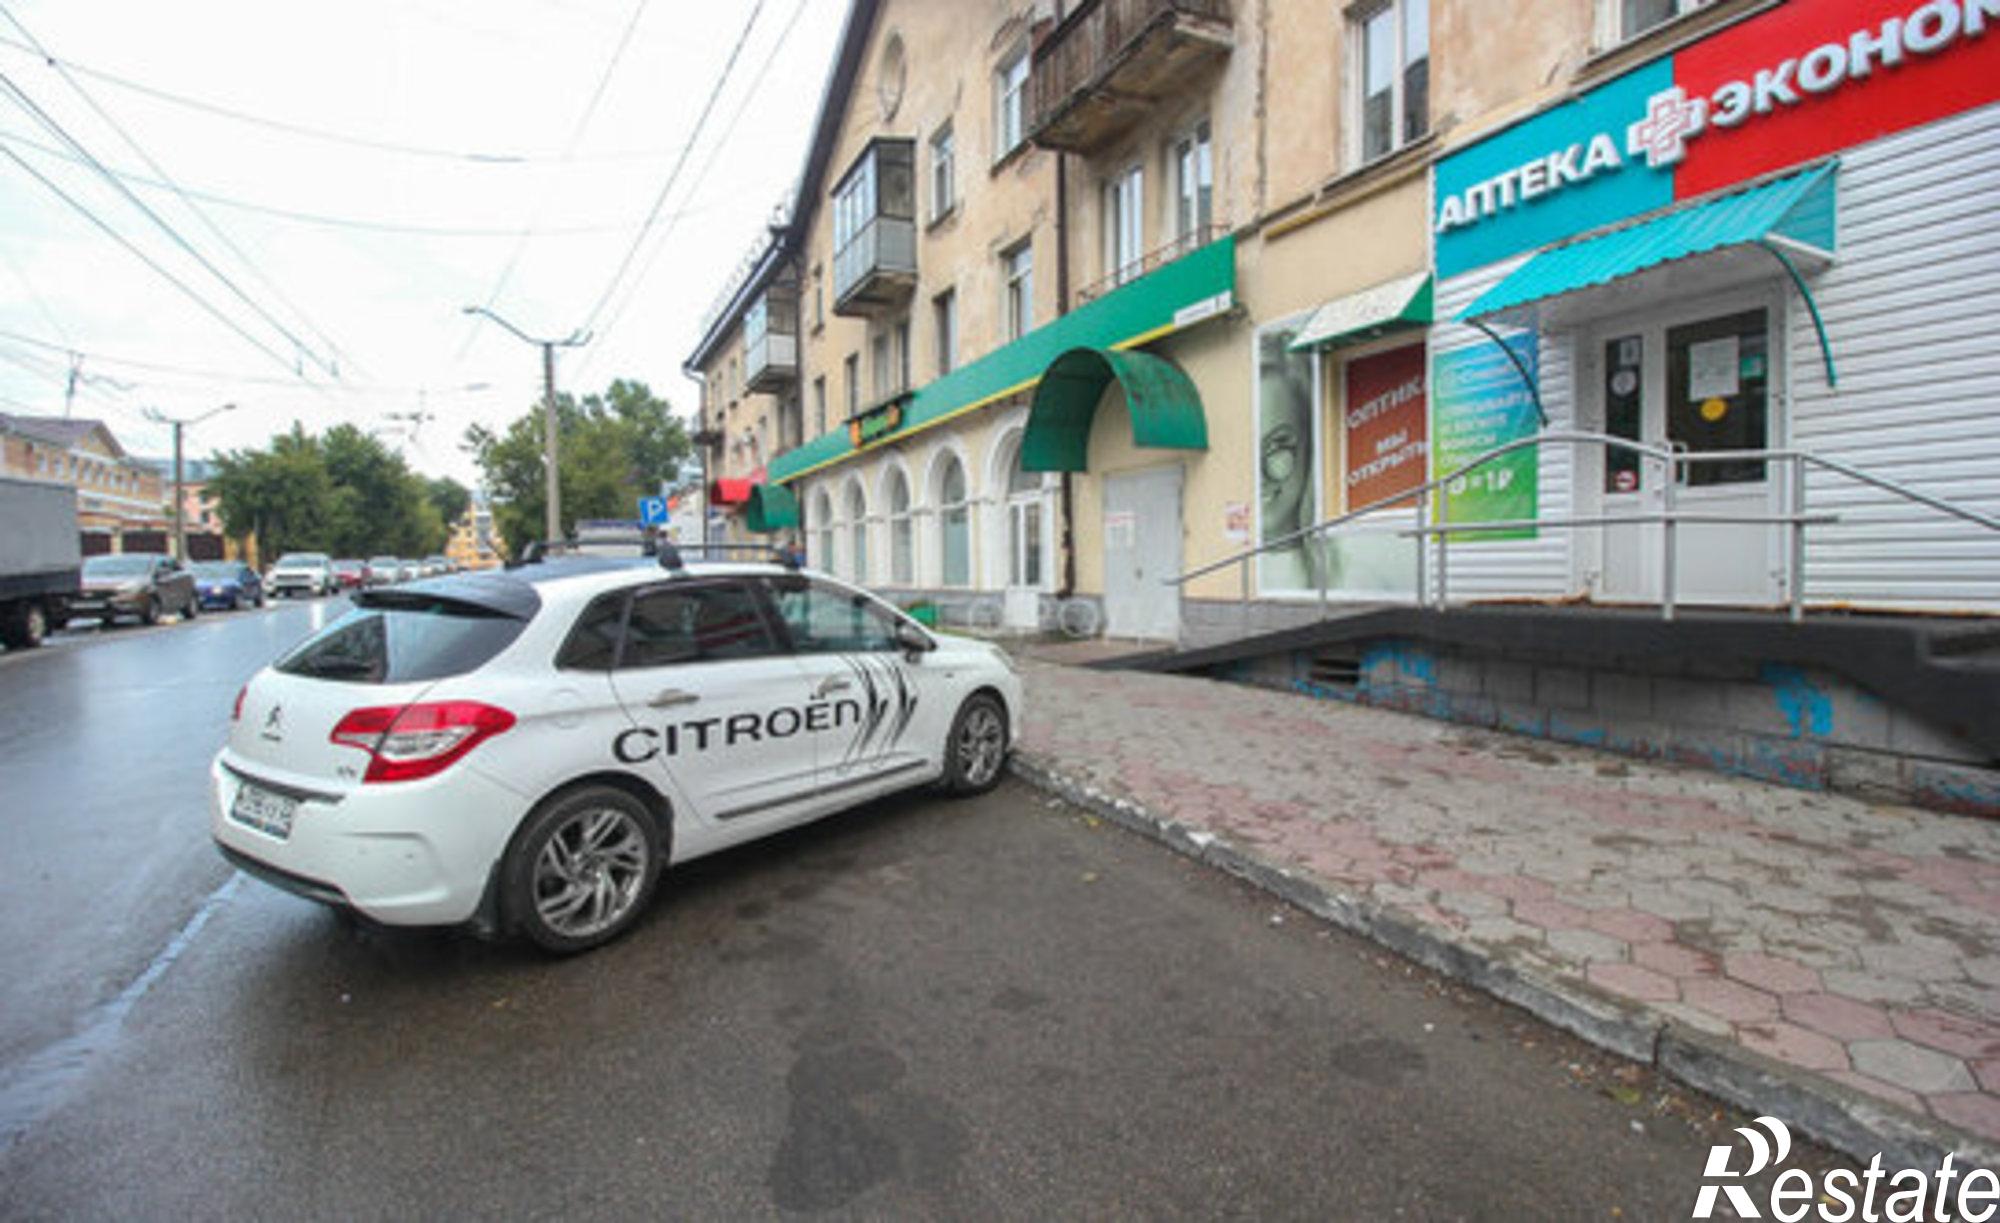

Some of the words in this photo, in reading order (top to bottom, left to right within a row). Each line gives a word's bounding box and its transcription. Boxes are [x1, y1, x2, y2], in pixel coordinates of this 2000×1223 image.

[1437, 133, 1621, 233] АПТЕКА
[1346, 376, 1425, 428] ОПТИК
[1376, 428, 1407, 453] МЫ
